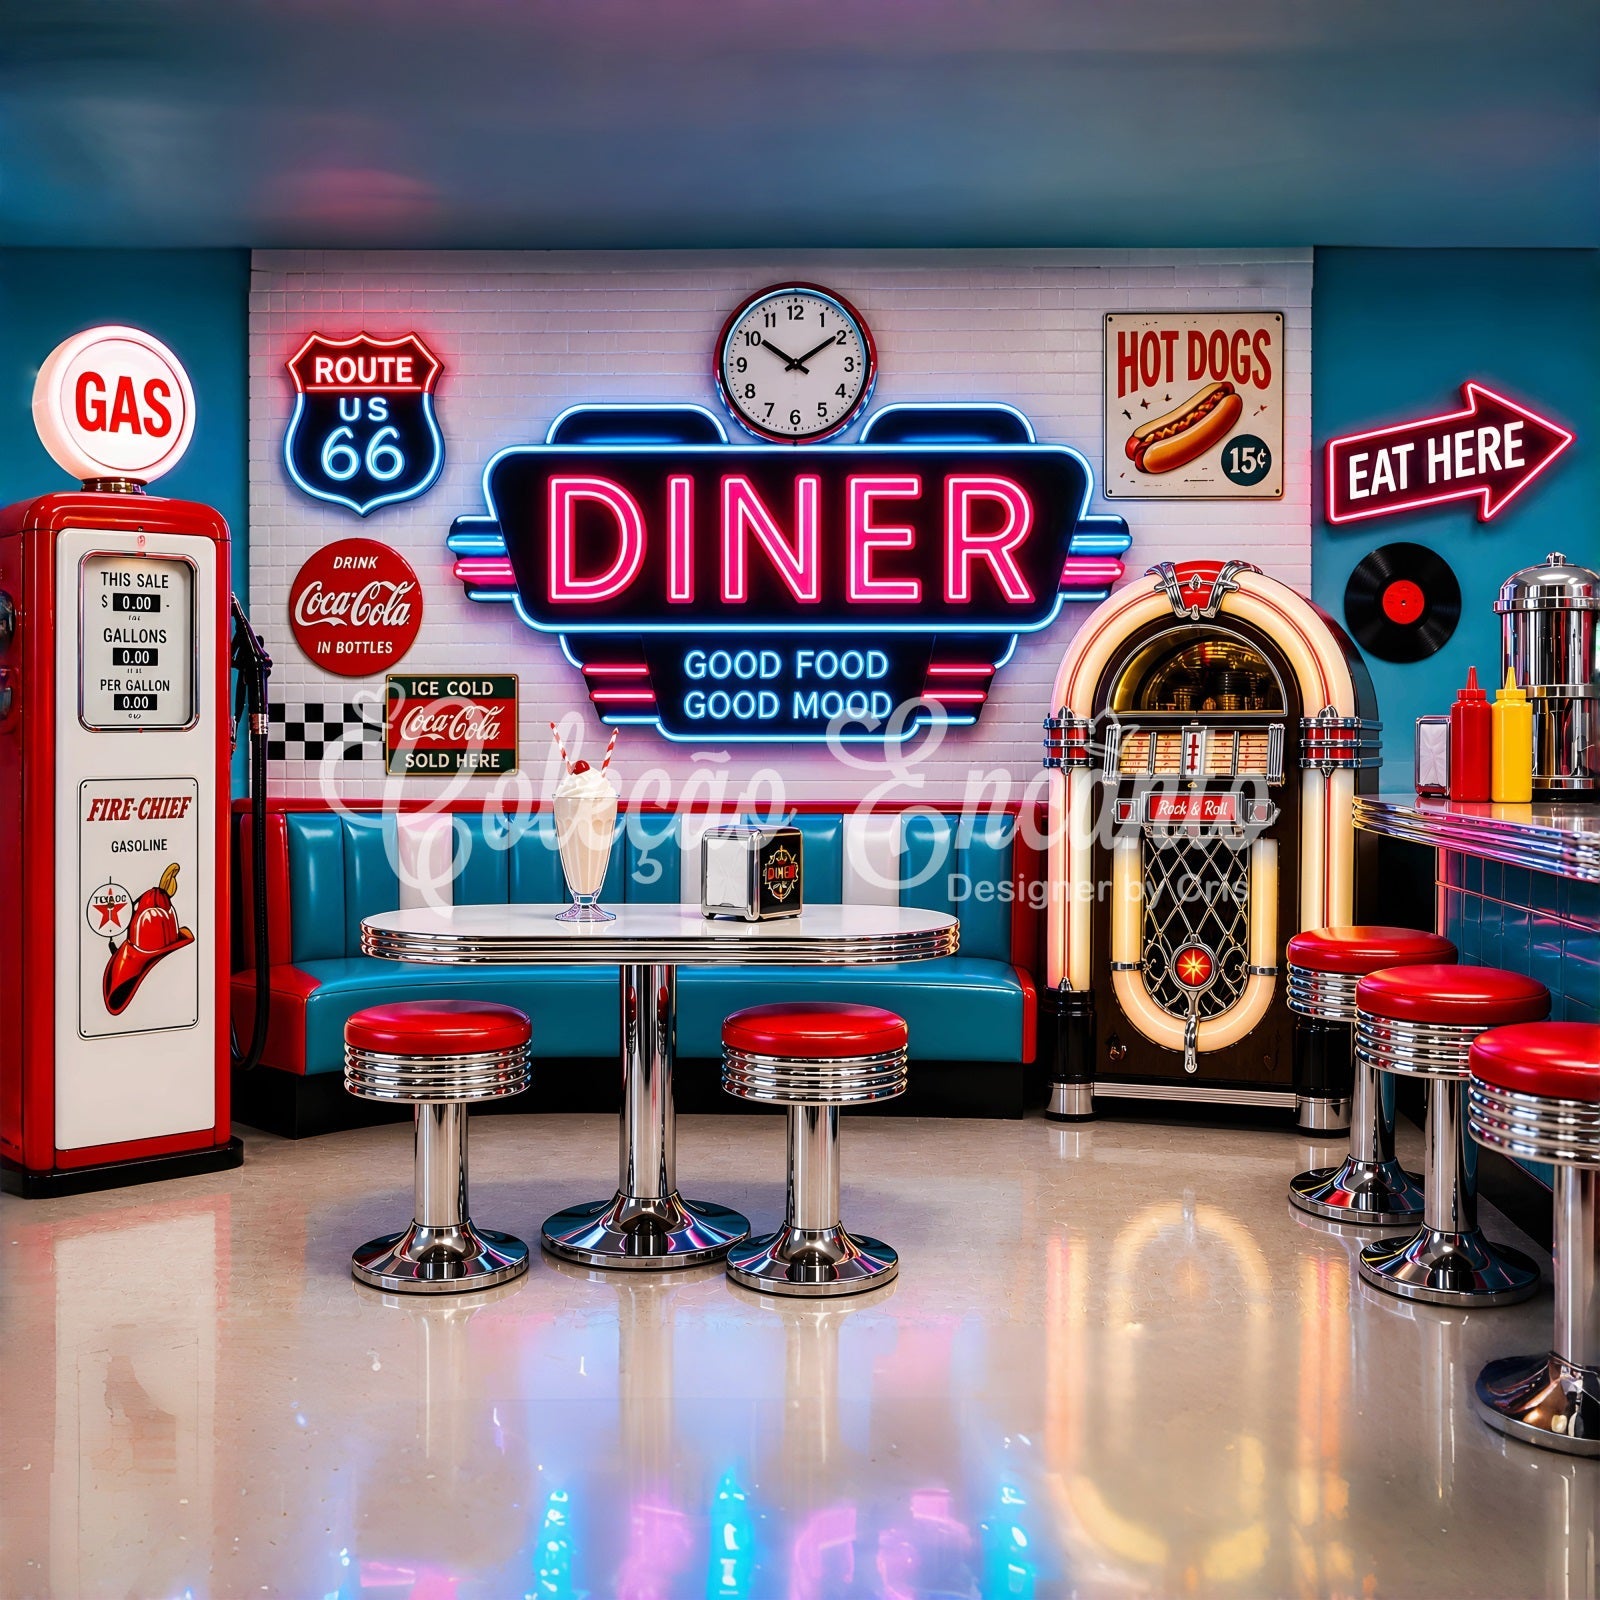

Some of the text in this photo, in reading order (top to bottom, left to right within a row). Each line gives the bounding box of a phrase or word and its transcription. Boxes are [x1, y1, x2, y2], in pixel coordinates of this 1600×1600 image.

[764, 312, 776, 327] 11
[786, 305, 804, 320] 12
[819, 312, 825, 327] 1
[744, 330, 762, 346] 10
[835, 330, 847, 345] 2
[314, 356, 413, 384] ROUTE
[736, 357, 748, 373] 9
[843, 357, 854, 372] 3
[1117, 328, 1272, 399] HOT DOGS
[744, 383, 756, 399] 8
[835, 383, 847, 398] 4
[75, 371, 172, 438] GAS
[764, 402, 775, 417] 7
[817, 402, 828, 417] 5
[789, 409, 801, 425] 6
[321, 426, 406, 482] 66
[1229, 447, 1267, 474] 15¢
[1349, 420, 1526, 500] EAT HERE
[547, 474, 1036, 604] DINER
[333, 556, 378, 569] DRINK
[100, 571, 169, 589] THIS SALE
[101, 594, 151, 610] $ 0.00
[294, 580, 416, 627] Coca-Cola
[103, 627, 167, 644] GALLONS
[317, 641, 393, 654] IN BOTTLES
[122, 649, 150, 664] 0.00
[683, 649, 890, 680] GOOD FOOD
[100, 679, 170, 692] PER GALLON
[411, 681, 493, 696] ICE COLD
[122, 696, 149, 709] 0.00
[683, 690, 893, 720] GOOD MOOD
[400, 705, 505, 741] Coca-Cola
[405, 753, 500, 769] SOLD HERE
[86, 796, 193, 822] FIRE-CHIEF
[1158, 800, 1228, 816] Rock & Roll
[111, 839, 168, 853] GASOLINE
